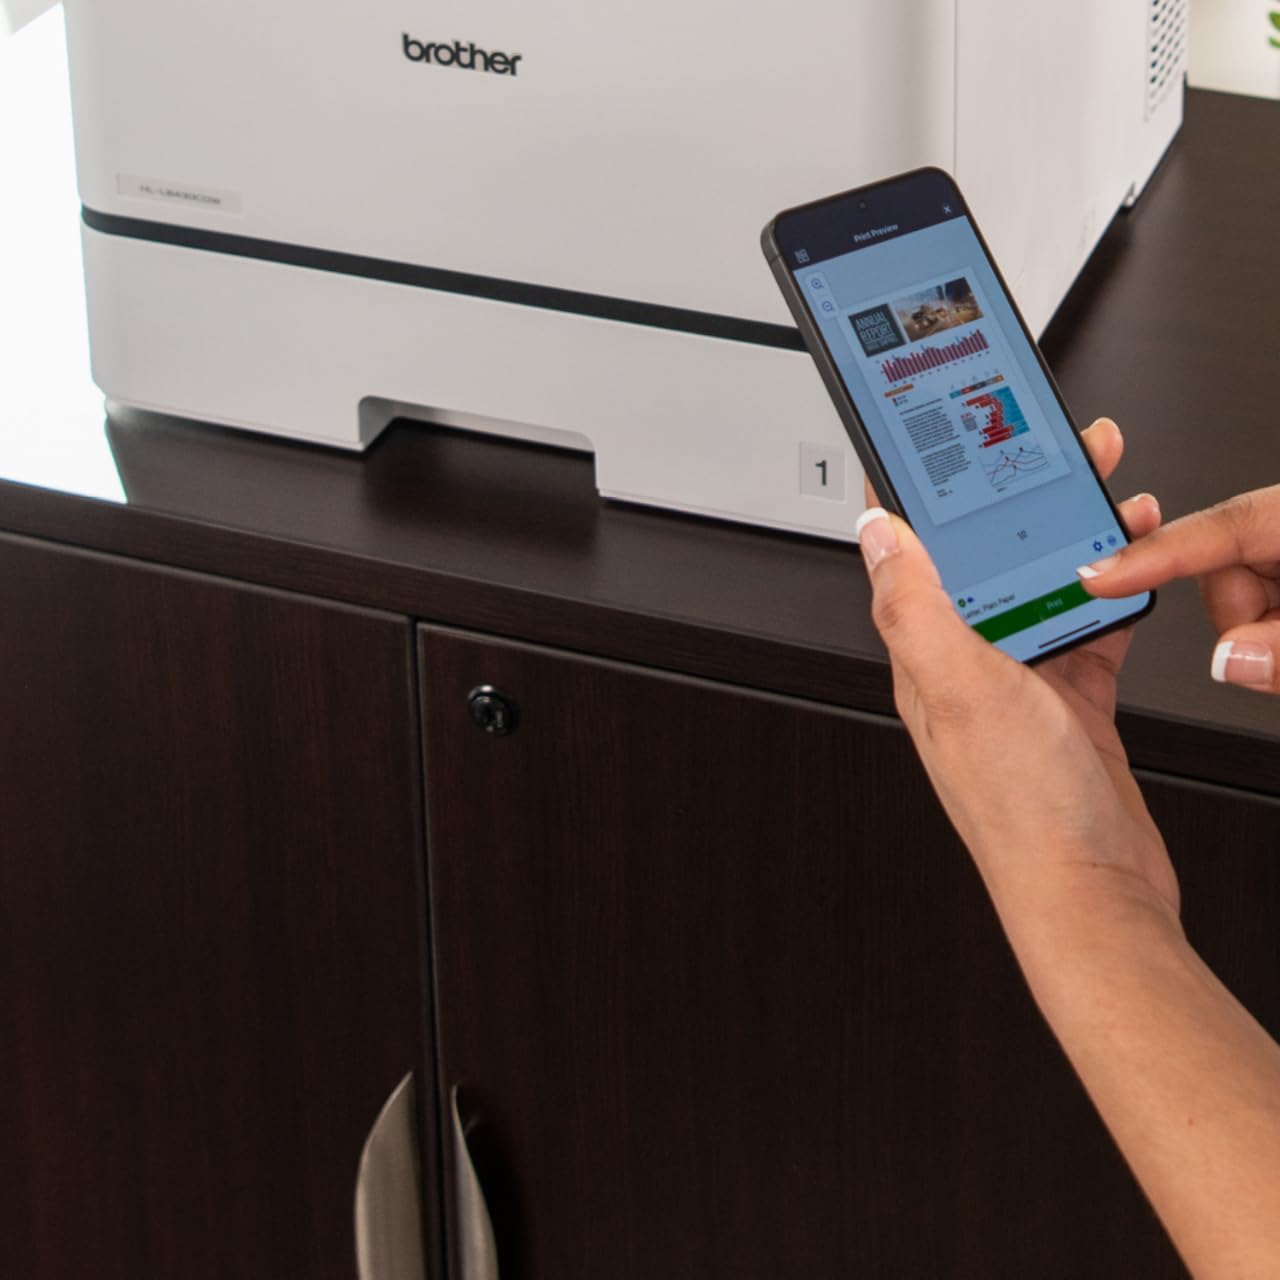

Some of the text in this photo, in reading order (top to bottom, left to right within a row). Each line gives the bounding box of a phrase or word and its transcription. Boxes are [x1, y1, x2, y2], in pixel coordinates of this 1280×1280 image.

[402, 32, 522, 76] brother
[853, 224, 898, 242] Print Preview
[856, 311, 887, 330] ANNUAL
[860, 321, 894, 343] REPORT
[815, 459, 827, 486] 1
